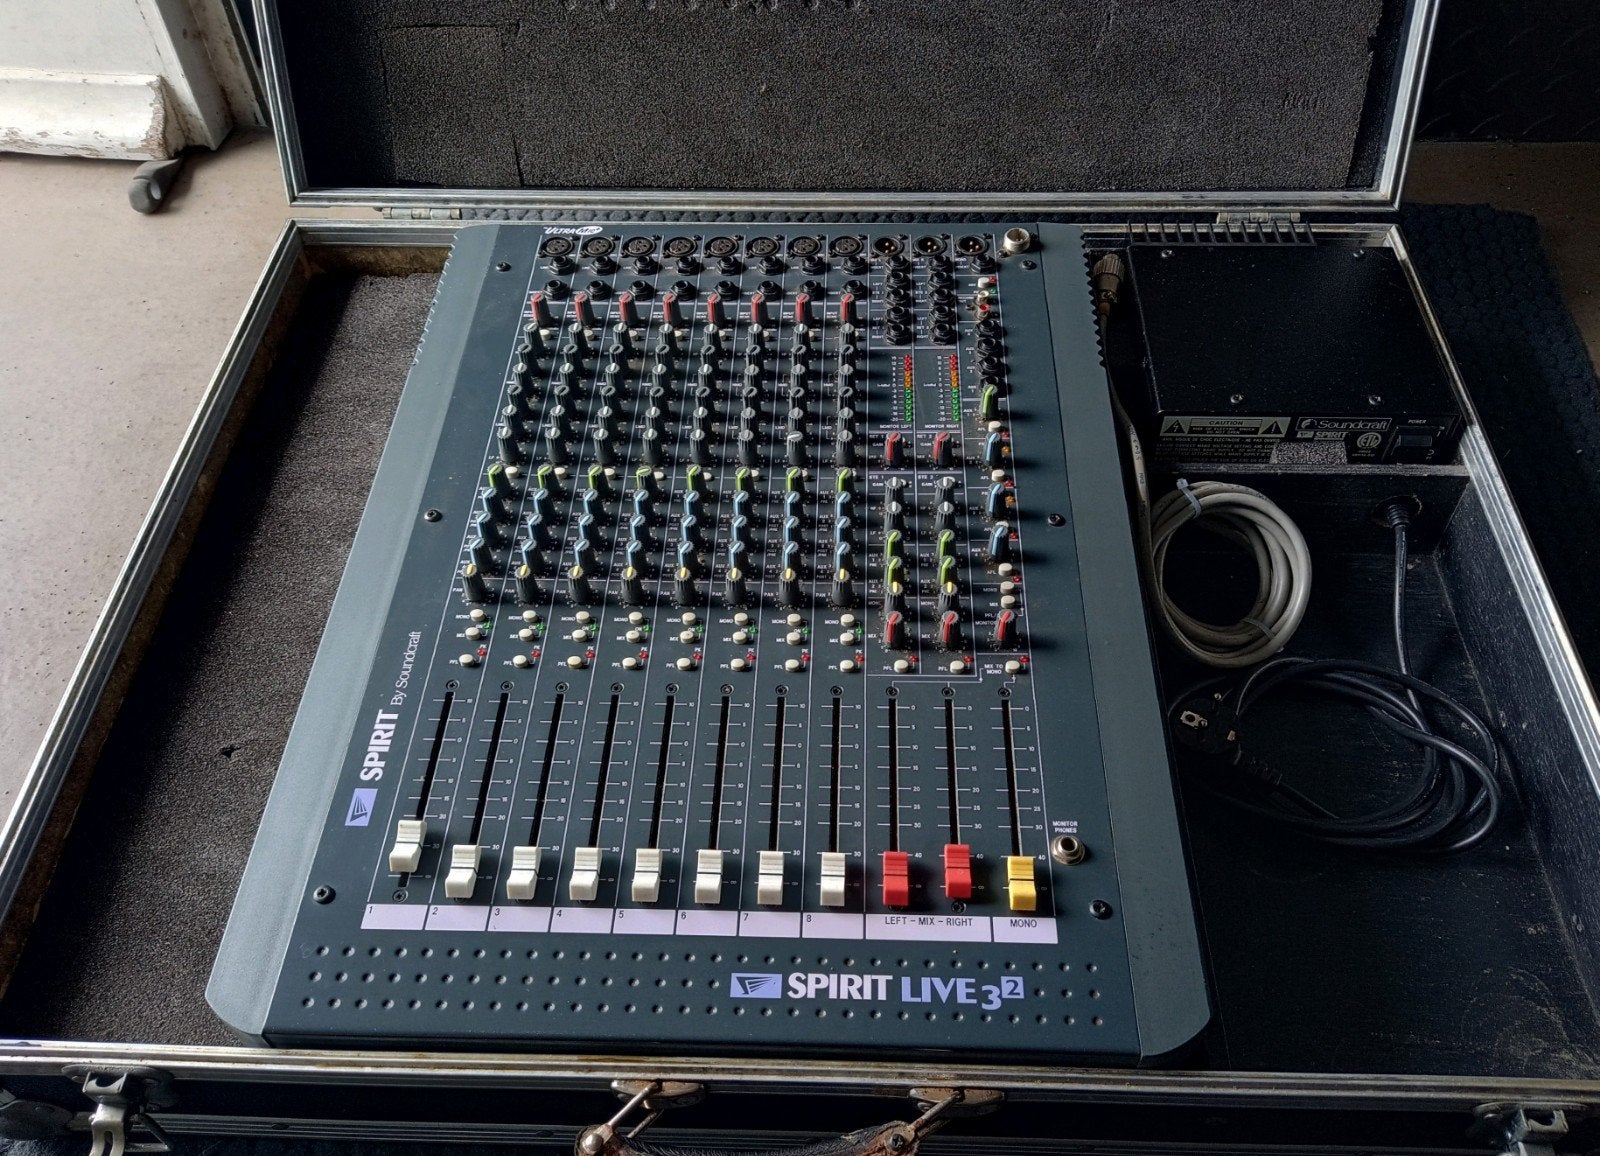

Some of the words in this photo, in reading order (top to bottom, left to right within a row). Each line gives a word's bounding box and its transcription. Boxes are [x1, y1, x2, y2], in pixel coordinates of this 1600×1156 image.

[1318, 420, 1388, 429] Soundcraft
[396, 630, 422, 688] Soundcraft
[390, 688, 406, 706] By
[359, 709, 399, 782] SPIRIT
[368, 906, 374, 914] 1
[432, 906, 438, 915] 2
[494, 908, 500, 917] 3
[556, 909, 562, 918] 4
[618, 910, 624, 919] 5
[680, 911, 687, 920] 6
[743, 913, 749, 921] 7
[806, 914, 812, 922] 8
[885, 916, 907, 925] LEFT
[918, 917, 935, 926] MIX
[946, 918, 973, 927] RIGHT
[1010, 919, 1037, 928] MONO
[787, 972, 893, 1001] SPIRIT
[901, 976, 978, 1005] LIVE
